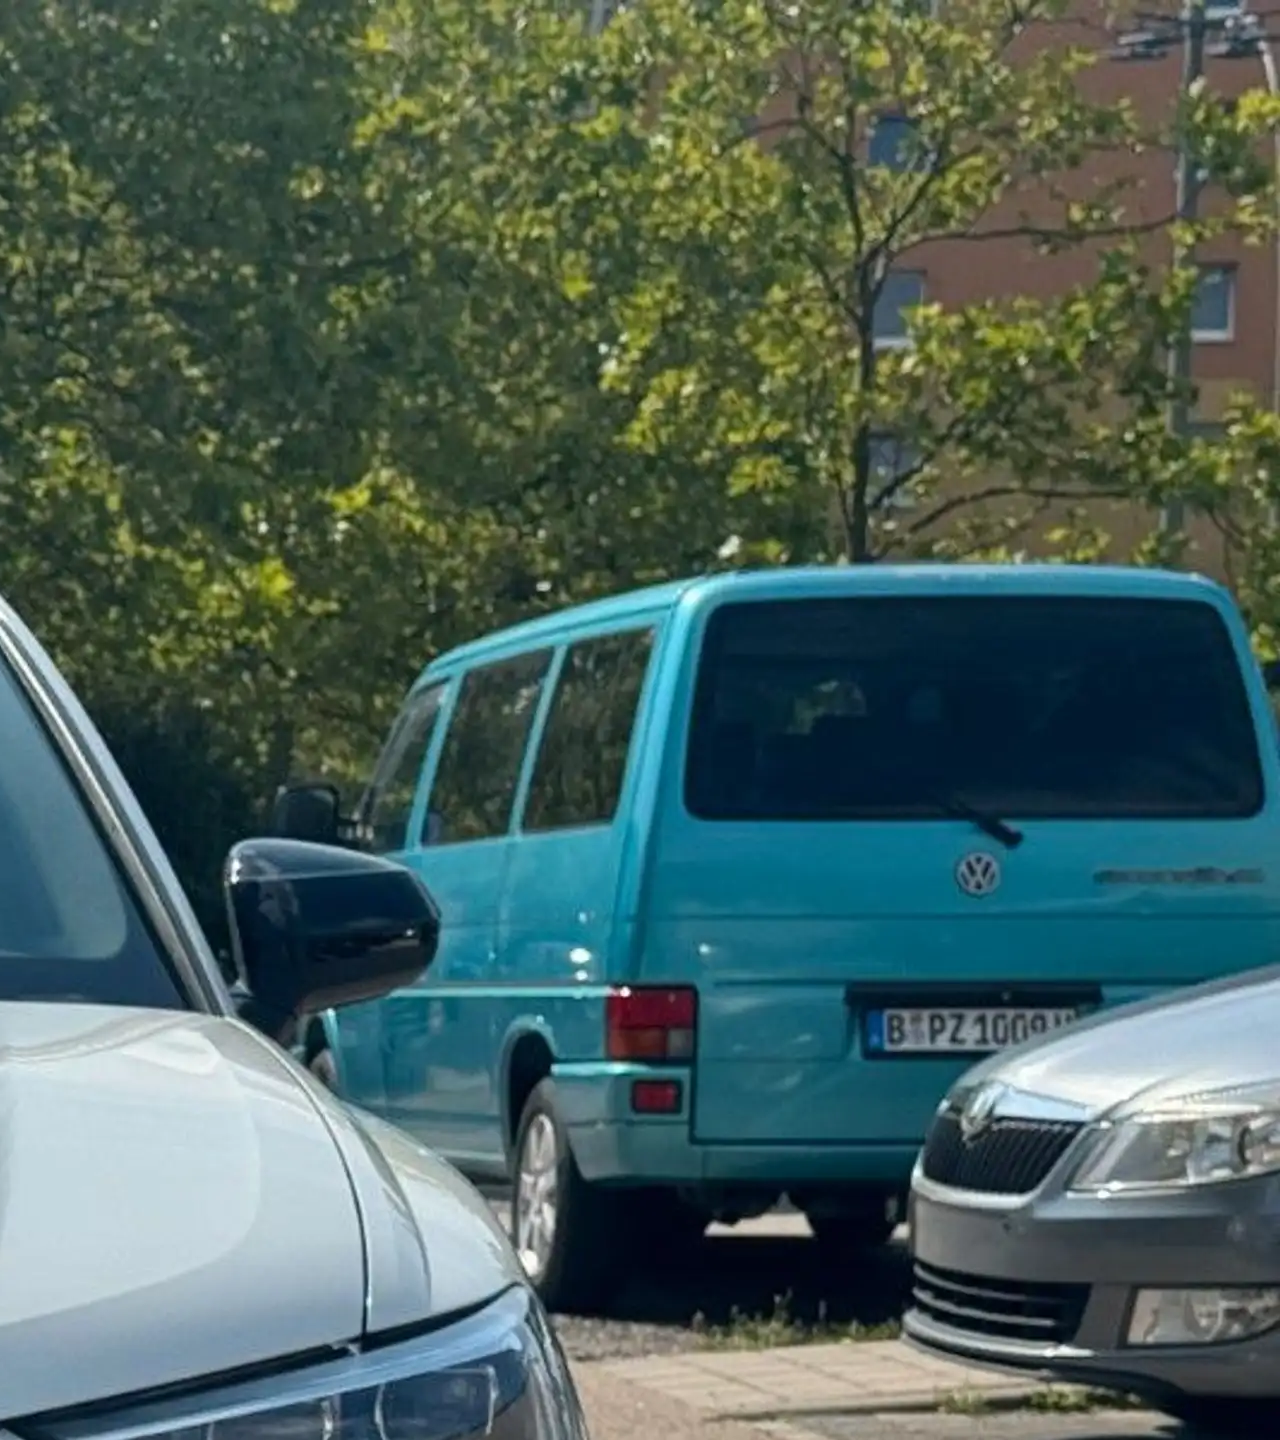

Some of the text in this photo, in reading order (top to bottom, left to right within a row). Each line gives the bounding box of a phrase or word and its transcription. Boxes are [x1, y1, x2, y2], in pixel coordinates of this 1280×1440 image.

[957, 853, 1000, 896] VW
[886, 1012, 906, 1046] B
[929, 1012, 967, 1046] PZ
